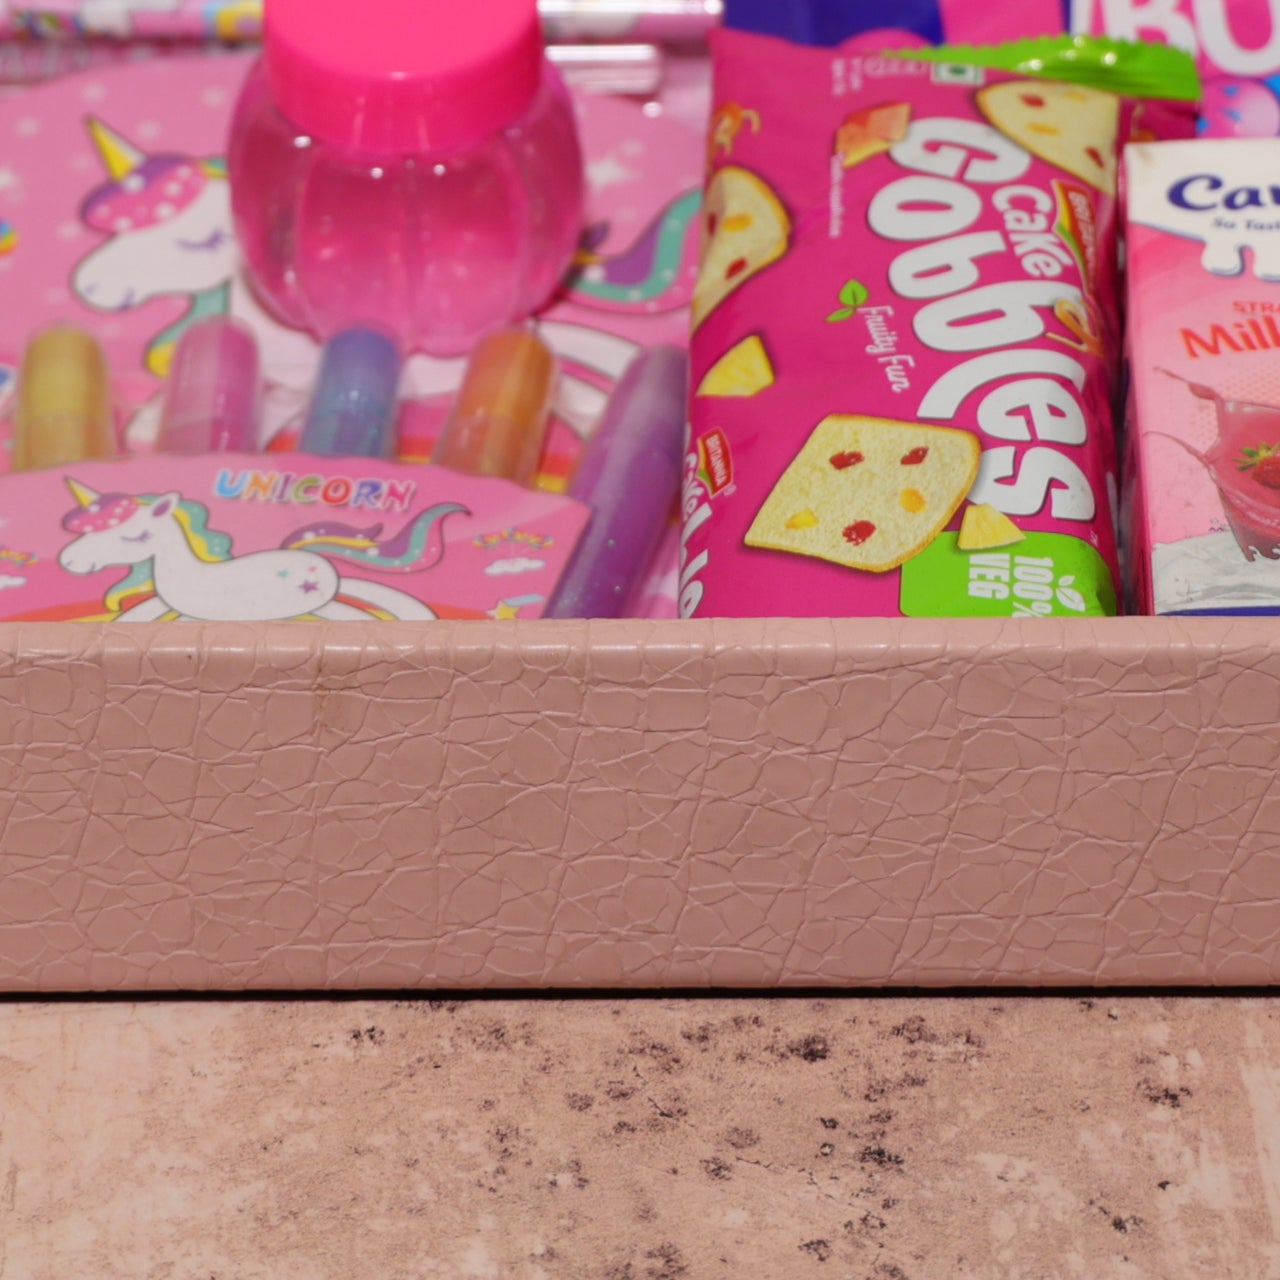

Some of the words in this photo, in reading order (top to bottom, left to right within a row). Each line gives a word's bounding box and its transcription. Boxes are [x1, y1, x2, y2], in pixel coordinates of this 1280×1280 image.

[857, 304, 896, 355] Fruity
[877, 354, 916, 394] Fun
[214, 468, 417, 512] UNICORN
[967, 551, 1012, 601] VEG
